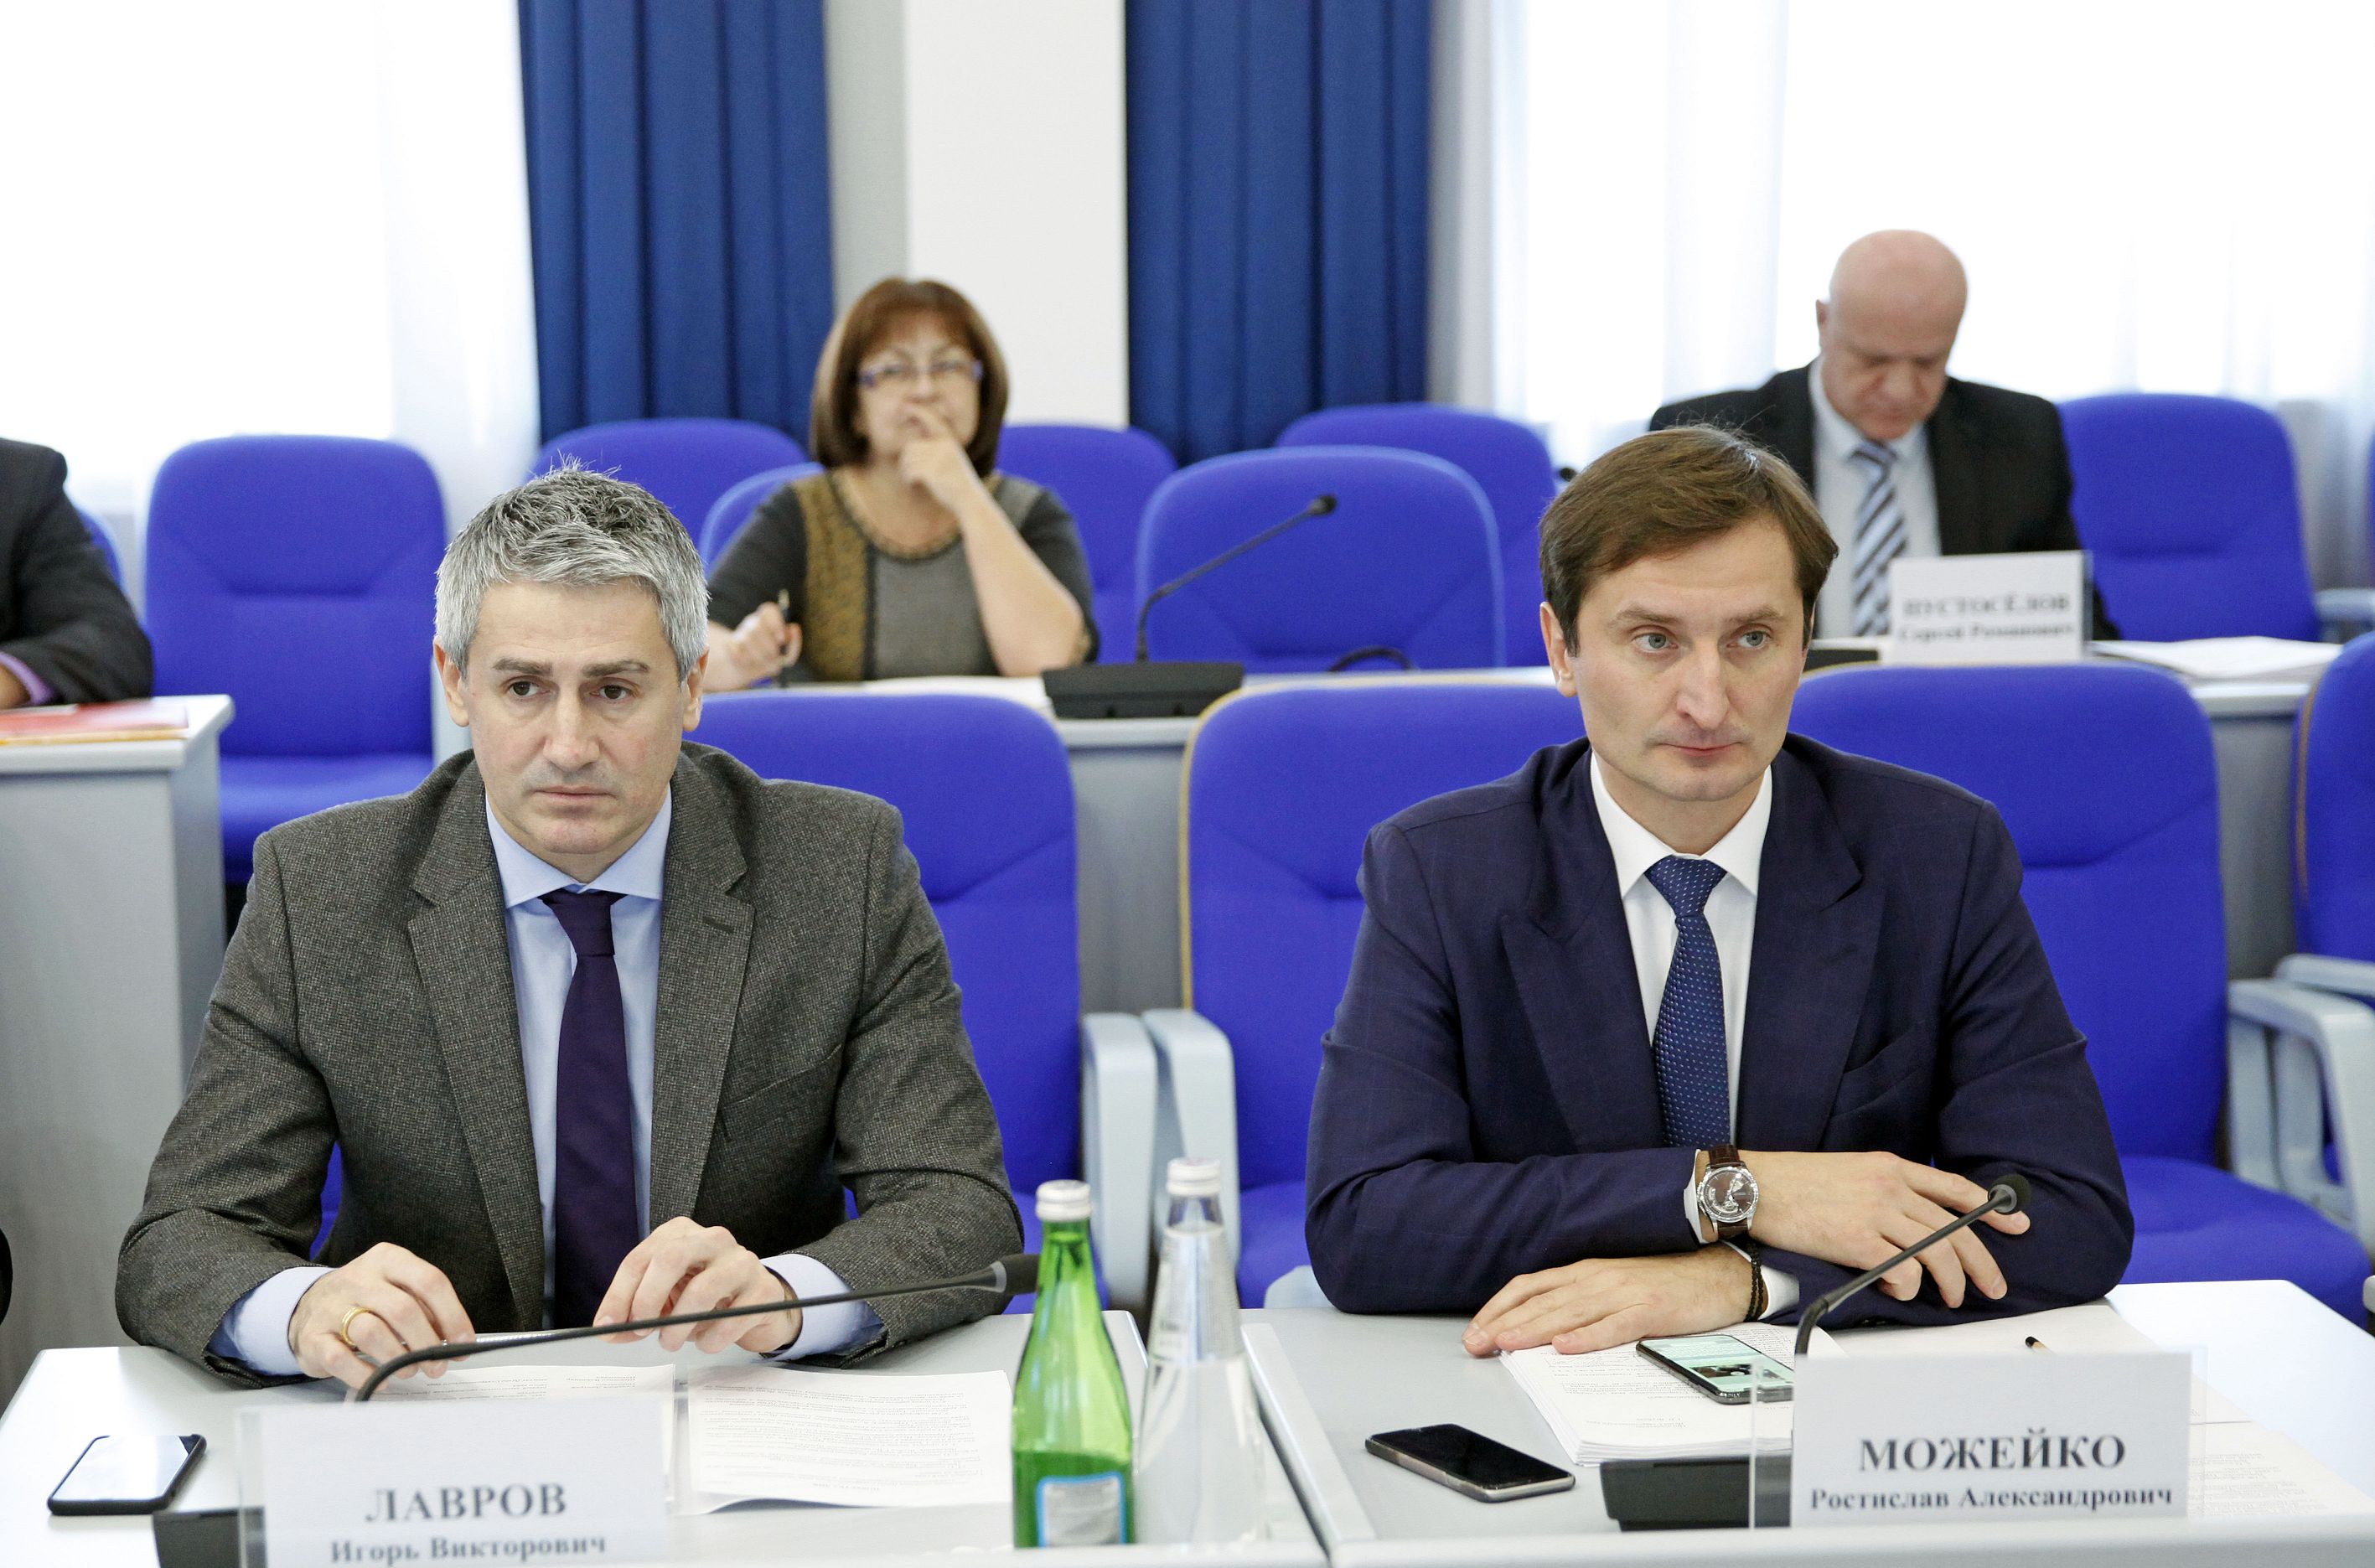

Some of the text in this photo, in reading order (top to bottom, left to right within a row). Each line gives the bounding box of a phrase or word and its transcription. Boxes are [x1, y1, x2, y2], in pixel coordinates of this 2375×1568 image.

[1859, 1427, 2127, 1472] МОЖЕЙКО
[365, 1483, 567, 1523] ЛАВРОВ
[1810, 1487, 2173, 1512] Ростислав Александрович
[330, 1536, 607, 1567] Игорь Викторович
